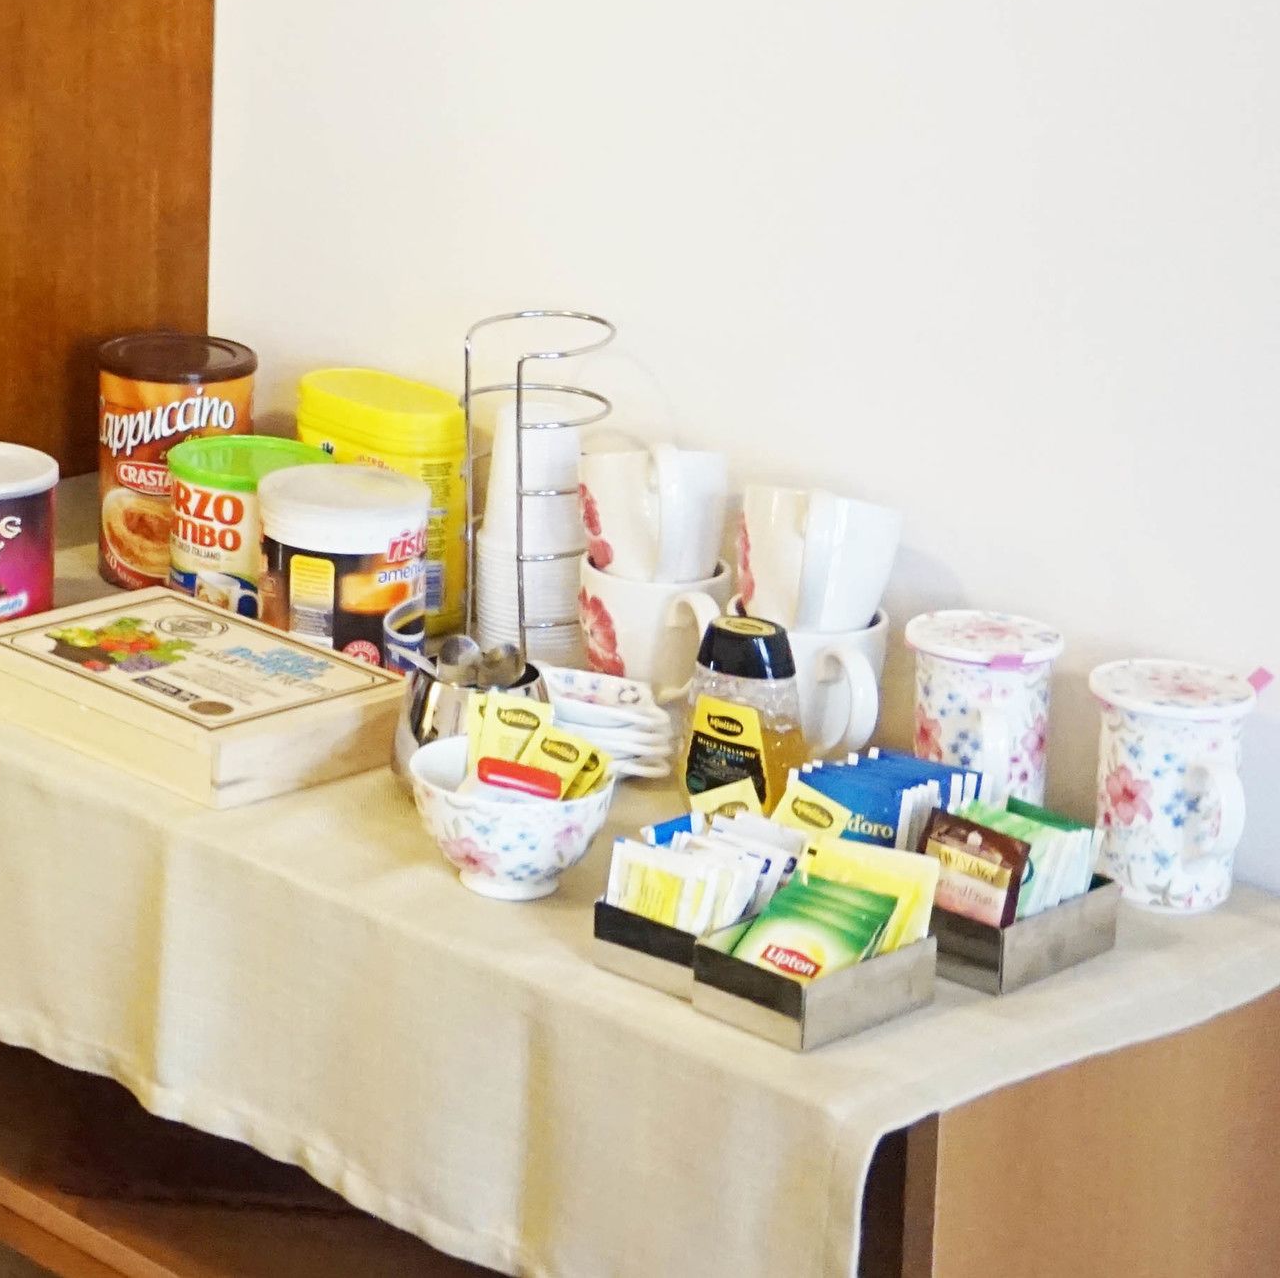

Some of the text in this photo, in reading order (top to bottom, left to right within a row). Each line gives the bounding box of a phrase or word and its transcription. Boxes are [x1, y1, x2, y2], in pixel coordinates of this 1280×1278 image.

[100, 388, 235, 457] appuccino
[119, 464, 172, 486] CRASTA
[173, 481, 244, 525] RZO
[388, 530, 426, 562] rist
[766, 945, 817, 977] Lipton
